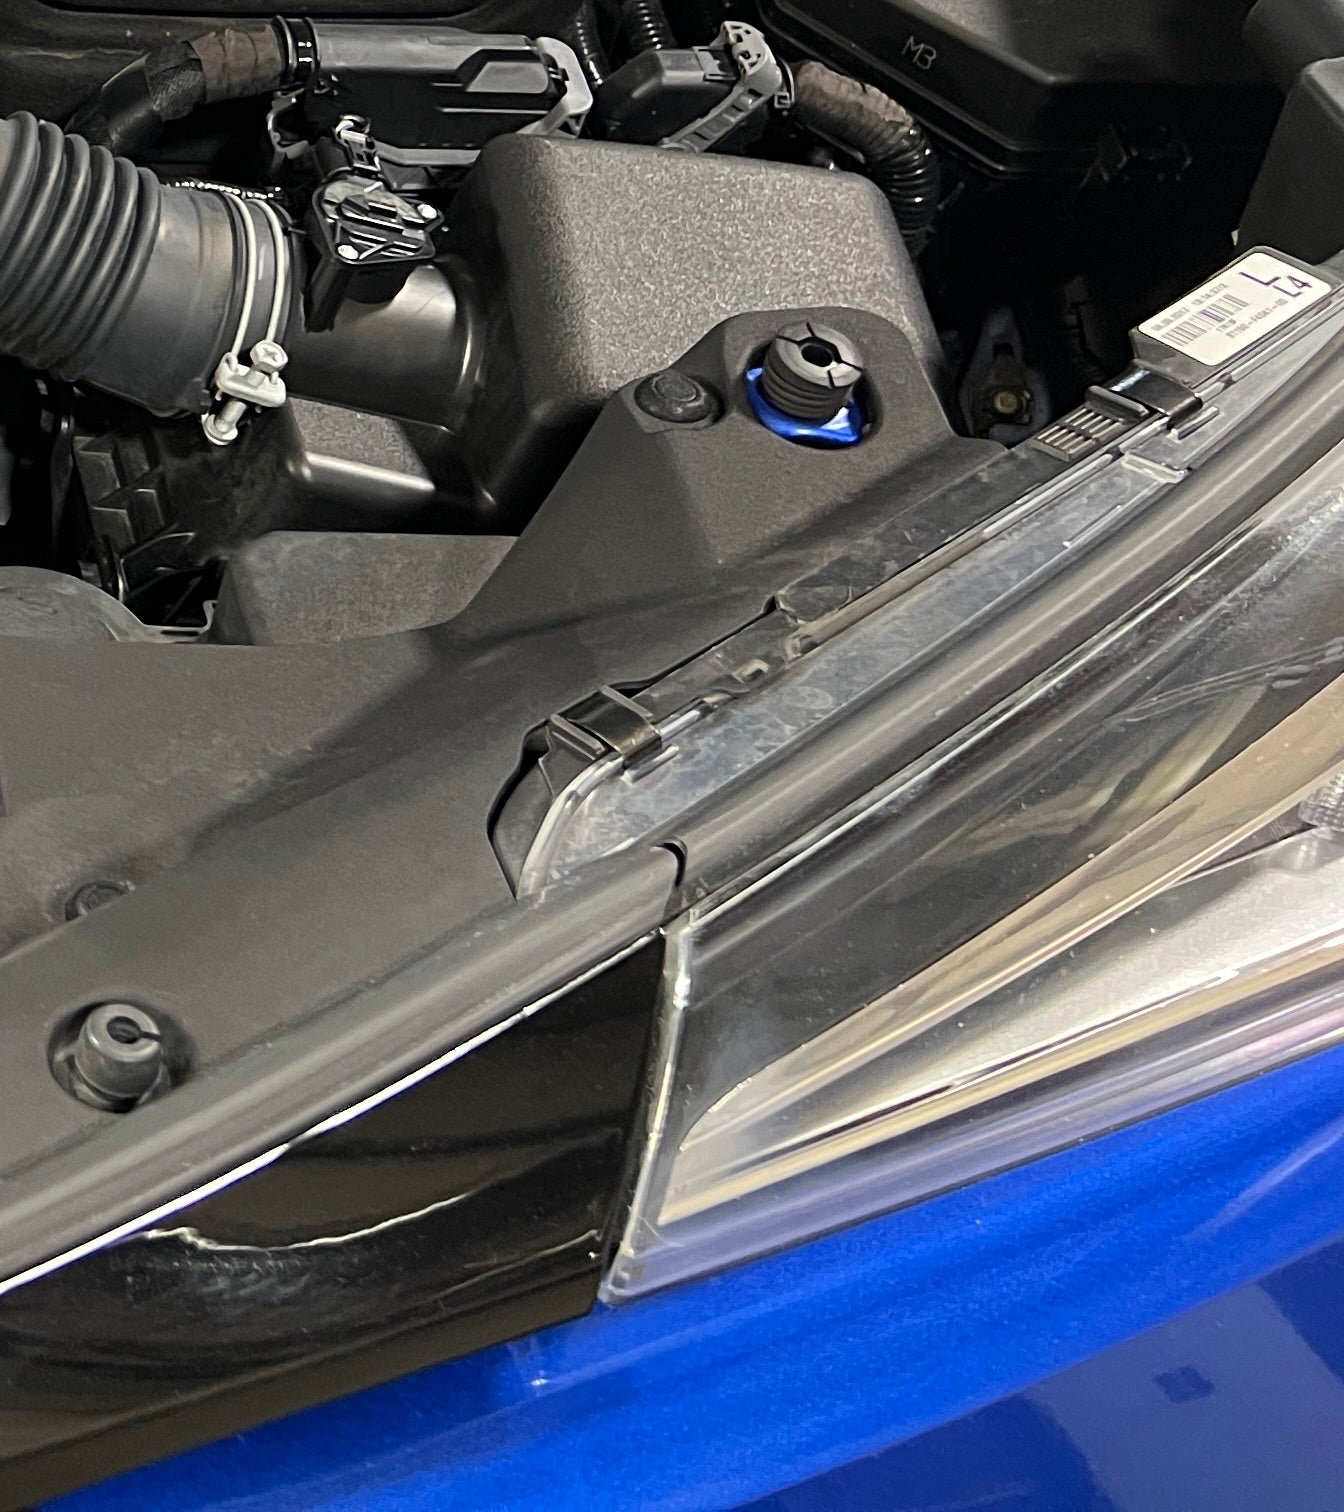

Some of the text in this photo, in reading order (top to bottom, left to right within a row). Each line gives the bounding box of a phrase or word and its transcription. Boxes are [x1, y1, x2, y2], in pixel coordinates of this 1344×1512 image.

[901, 35, 937, 70] M3
[1238, 270, 1282, 287] L
[1272, 274, 1313, 298] L4
